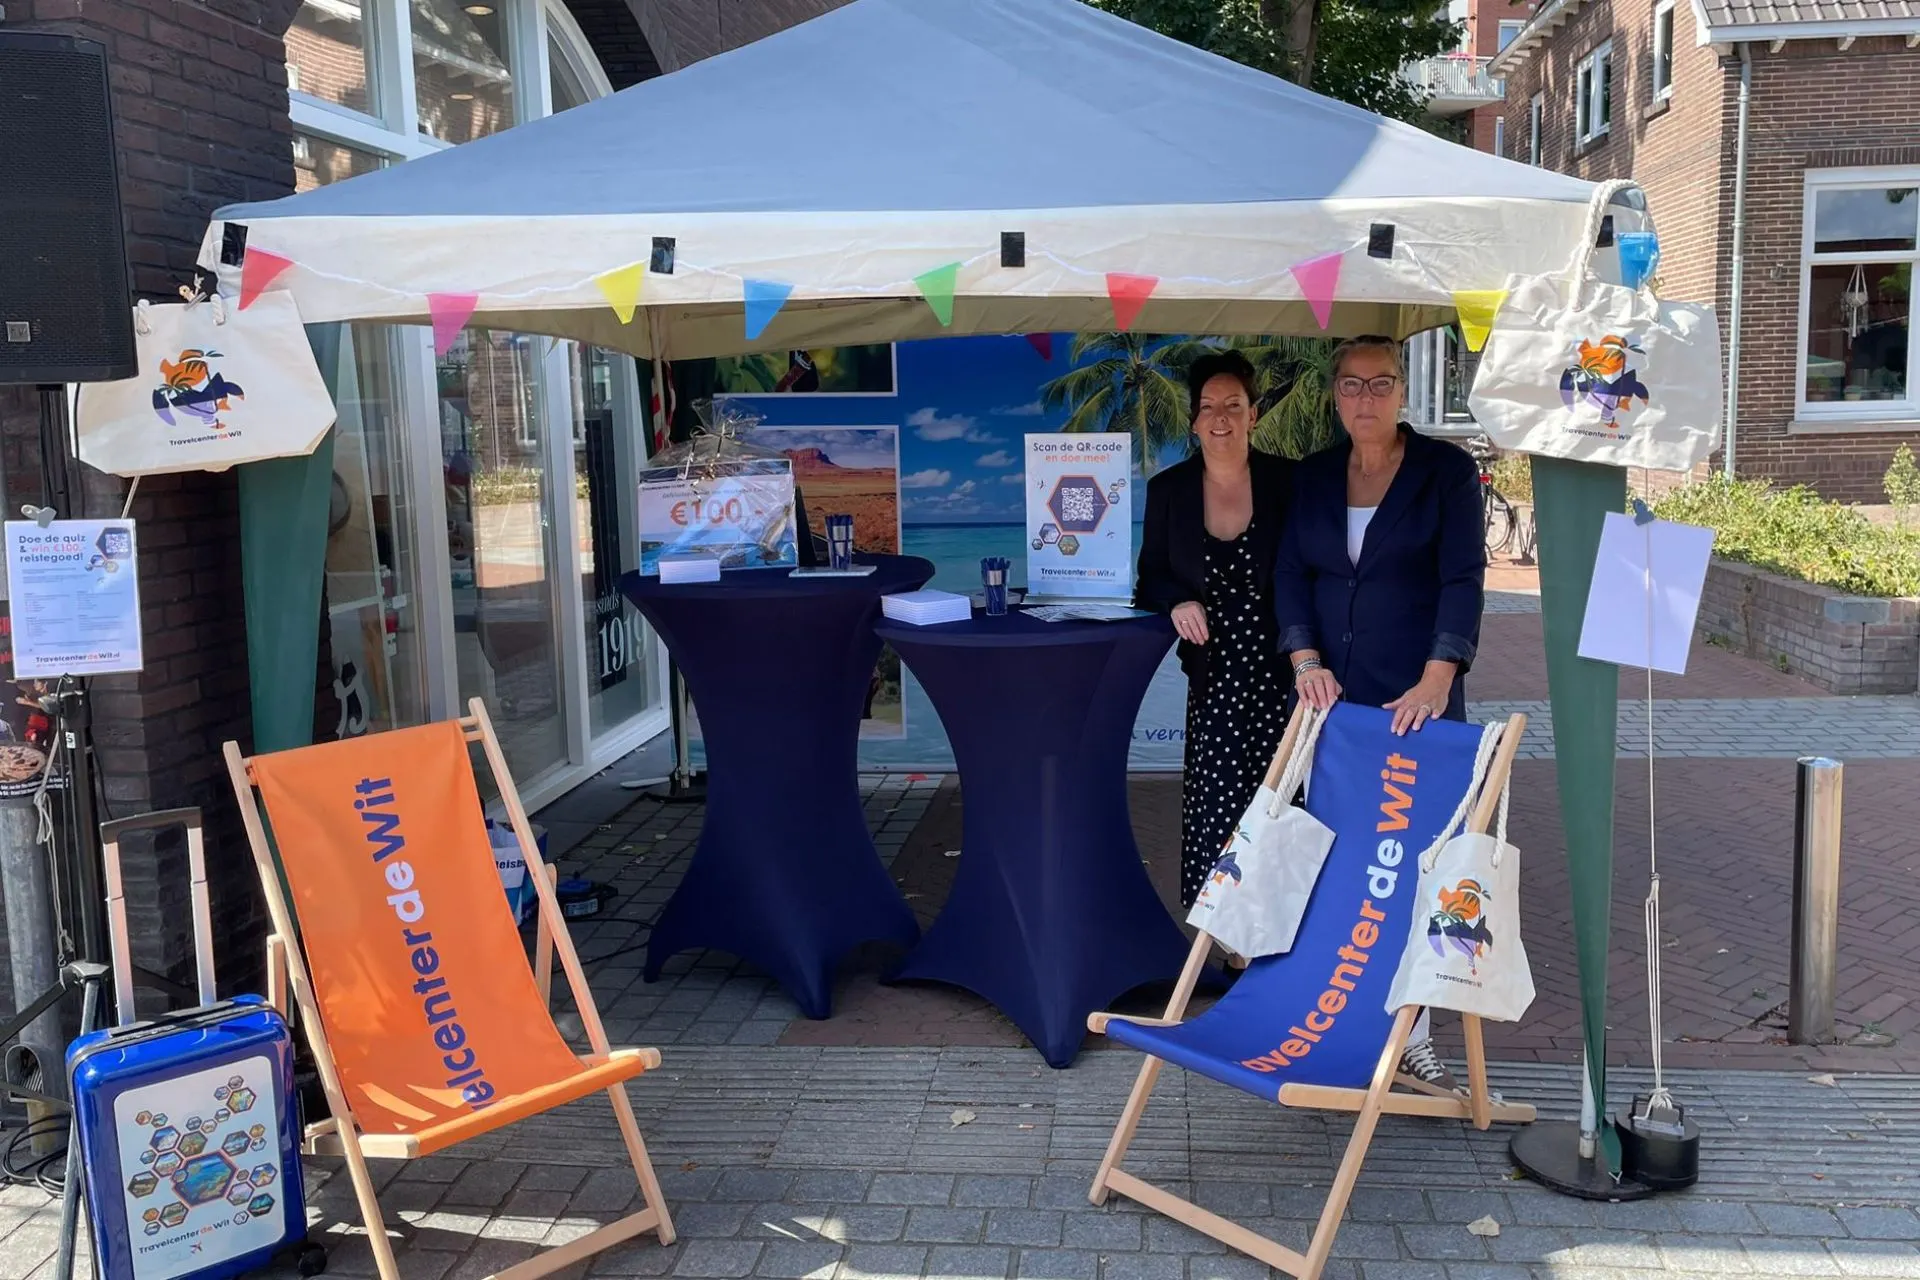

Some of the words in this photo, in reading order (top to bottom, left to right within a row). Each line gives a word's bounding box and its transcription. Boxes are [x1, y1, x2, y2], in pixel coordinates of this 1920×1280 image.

[1033, 442, 1057, 452] Scan
[1060, 442, 1074, 452] de
[1076, 442, 1122, 452] QR-code
[1045, 454, 1057, 462] en
[1061, 453, 1081, 462] doe
[1084, 453, 1111, 462] mee!
[19, 535, 41, 544] Doe
[45, 534, 59, 543] de
[63, 533, 86, 544] quiz
[31, 544, 50, 553] win
[20, 552, 84, 563] reistegoed!
[596, 586, 619, 613] sinds
